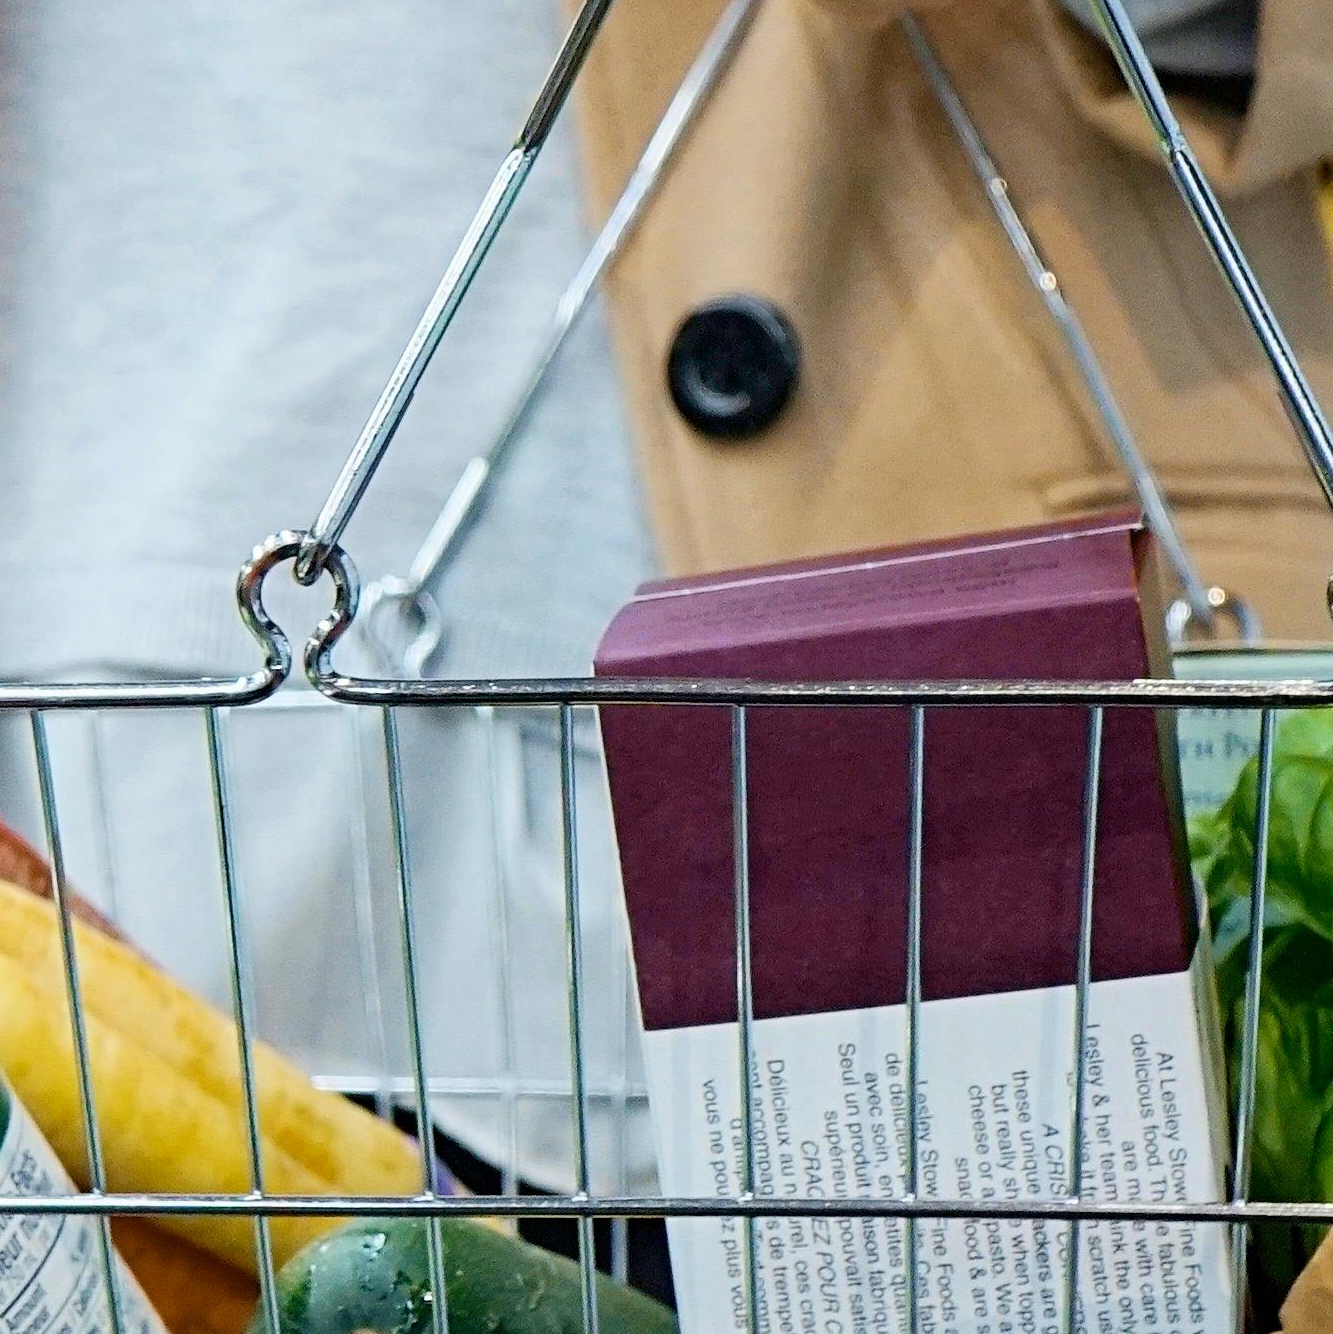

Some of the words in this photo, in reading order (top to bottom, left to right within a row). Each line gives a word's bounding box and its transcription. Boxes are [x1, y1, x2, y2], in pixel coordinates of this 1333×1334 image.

[837, 1042, 859, 1086] Seul
[884, 1051, 902, 1076] de
[1130, 1032, 1155, 1119] delicious
[1156, 1051, 1175, 1072] At
[701, 1079, 719, 1124] vous
[843, 1092, 859, 1116] un
[863, 1071, 882, 1117] avec
[990, 1082, 1011, 1115] but
[1011, 1068, 1032, 1124] these
[1091, 1093, 1110, 1108] &
[1159, 1078, 1181, 1142] Lesley
[967, 1083, 990, 1155] cheese
[1042, 1121, 1060, 1137] A
[1094, 1113, 1113, 1146] her
[708, 1130, 724, 1155] ne
[843, 1122, 873, 1189] produit
[869, 1121, 890, 1168] soin,
[995, 1119, 1017, 1172] really
[1019, 1129, 1042, 1195] unique
[1120, 1139, 1138, 1173] are
[1142, 1124, 1164, 1172] food.
[766, 1059, 791, 1147] Délicieux
[779, 1152, 795, 1177] au
[793, 1260, 811, 1294] ces
[876, 1173, 893, 1198] en
[977, 1160, 993, 1179] or
[1099, 1152, 1120, 1201] team
[719, 1238, 740, 1279] plus
[768, 1236, 785, 1261] de
[833, 1218, 863, 1286] pouvait
[1010, 1233, 1030, 1286] when
[1087, 1235, 1112, 1304] scratch
[1132, 1238, 1154, 1278] with
[814, 1249, 840, 1314] POUR
[934, 1262, 958, 1323] Foods
[968, 1266, 986, 1280] &
[1113, 1259, 1132, 1290] the
[1157, 1243, 1181, 1325] fabulous
[1183, 1263, 1206, 1324] Foods
[970, 1286, 988, 1318] are
[993, 1282, 1013, 1315] We
[1039, 1287, 1058, 1319] are
[1138, 1282, 1158, 1326] care
